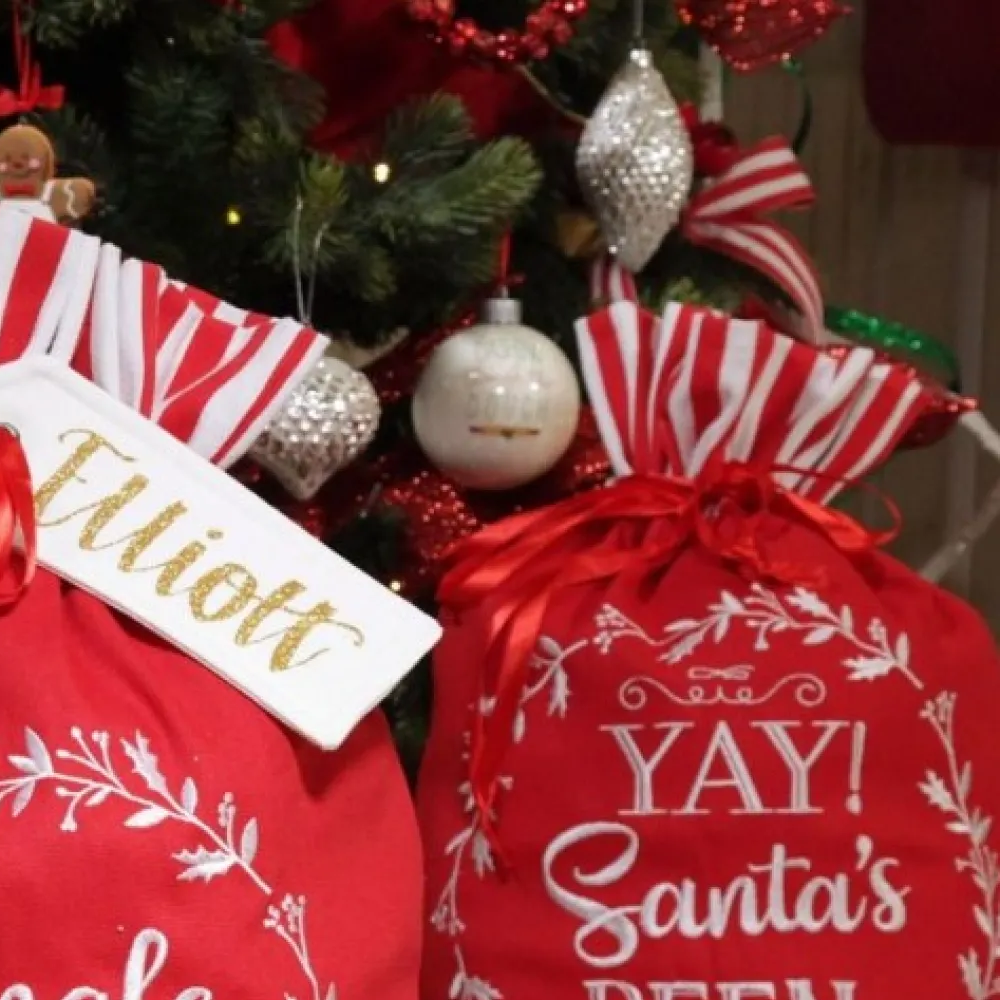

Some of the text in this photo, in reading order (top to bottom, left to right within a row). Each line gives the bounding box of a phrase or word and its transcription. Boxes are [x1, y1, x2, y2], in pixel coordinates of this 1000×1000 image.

[34, 428, 364, 672] Elliott
[600, 720, 866, 815] YAY!
[543, 821, 911, 967] Santa's
